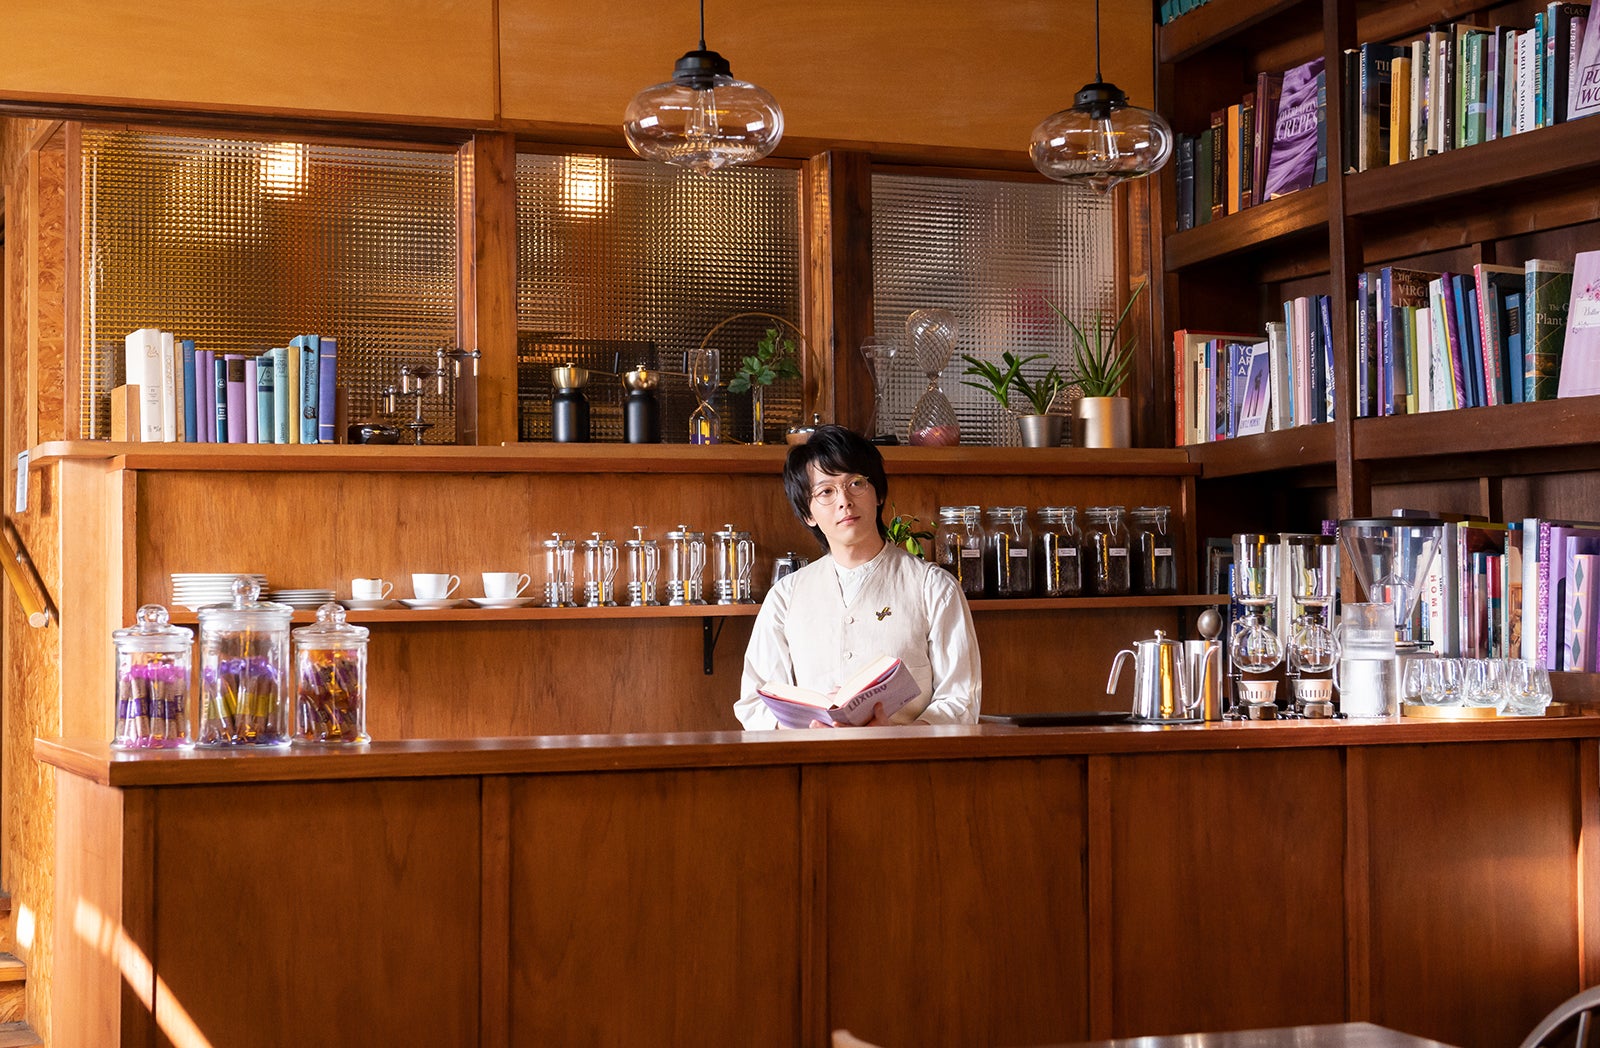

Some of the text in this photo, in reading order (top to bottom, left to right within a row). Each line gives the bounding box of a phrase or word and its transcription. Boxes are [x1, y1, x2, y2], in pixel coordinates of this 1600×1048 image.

[1276, 111, 1318, 142] CREPES
[1398, 284, 1428, 298] VIRGI
[1536, 313, 1562, 326] Plant
[1238, 366, 1246, 376] A
